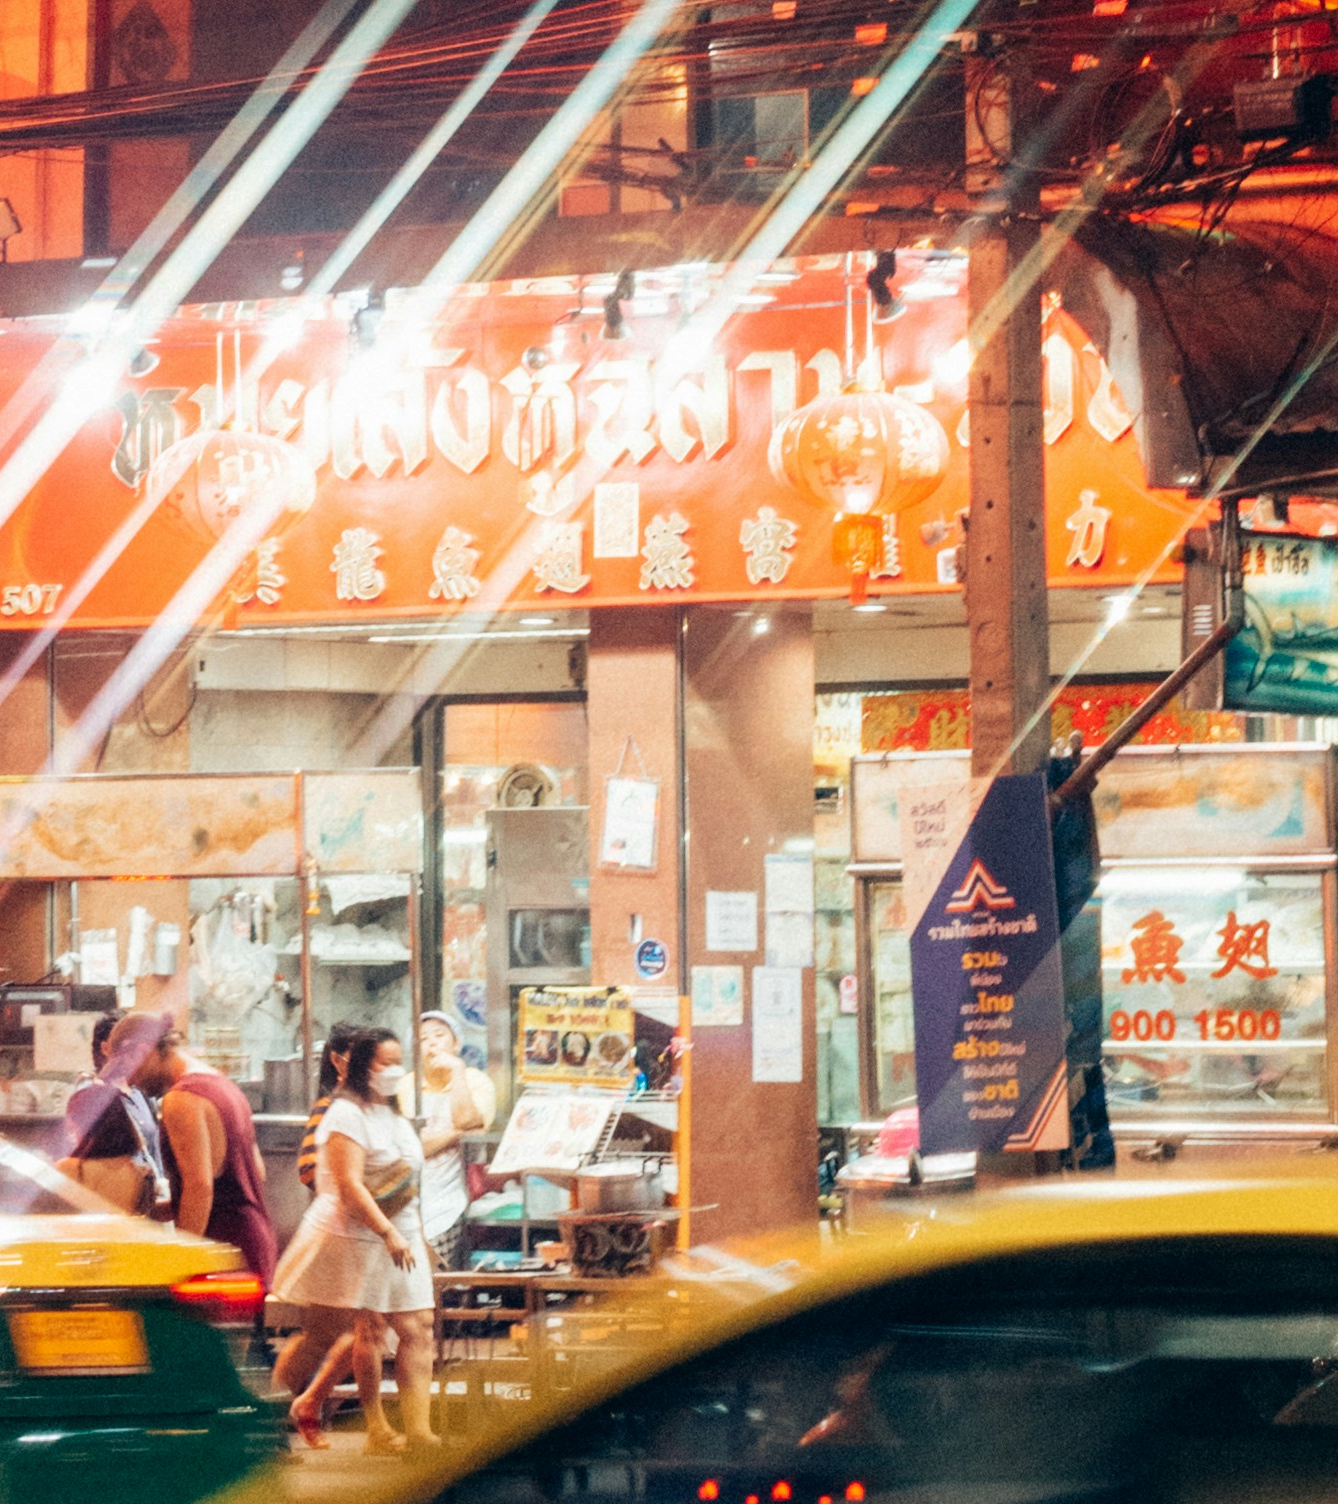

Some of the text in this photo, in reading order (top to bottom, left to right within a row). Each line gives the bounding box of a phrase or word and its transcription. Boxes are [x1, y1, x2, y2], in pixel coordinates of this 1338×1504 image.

[0, 584, 64, 616] 507
[1119, 909, 1280, 985] 魚翅
[1109, 1009, 1281, 1042] 900 1500
